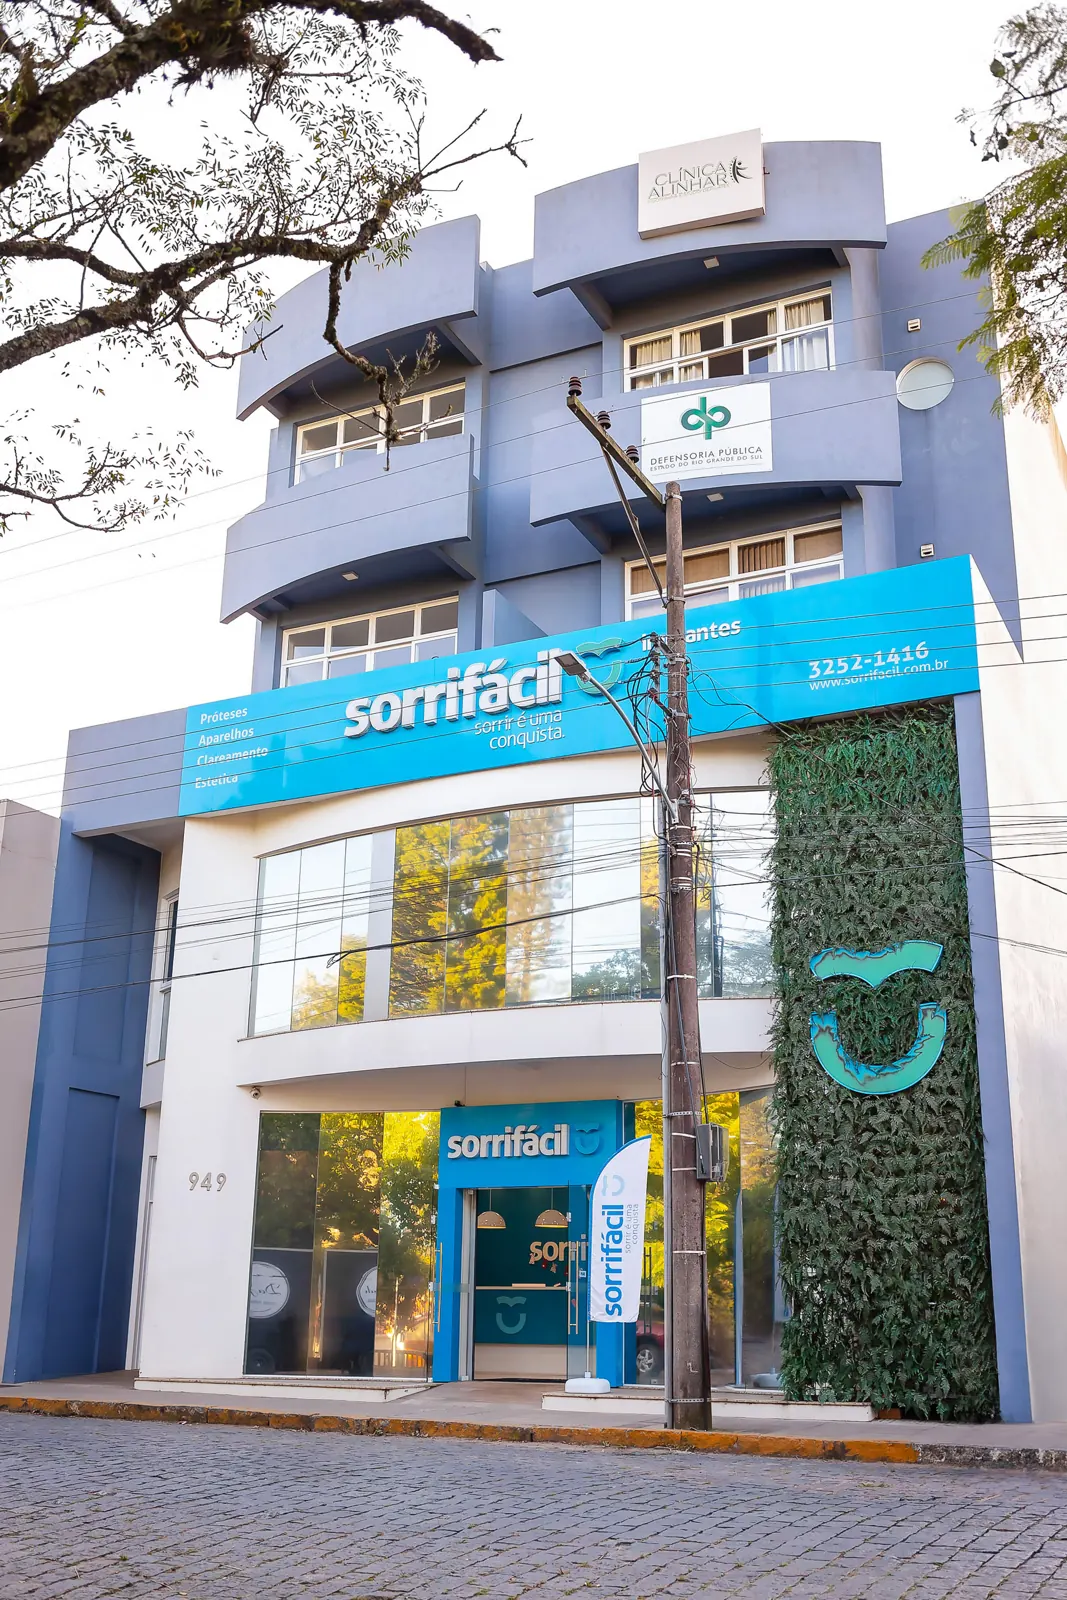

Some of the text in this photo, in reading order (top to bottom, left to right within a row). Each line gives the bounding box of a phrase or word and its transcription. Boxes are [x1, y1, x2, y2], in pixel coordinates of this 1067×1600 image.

[648, 174, 728, 200] ALINHAR
[655, 162, 727, 186] CLÍNICA
[650, 446, 763, 465] DEFENSORIA PÚBLICA
[650, 463, 676, 472] ESTADO
[706, 456, 735, 464] GRANDE
[808, 641, 929, 679] 3252-1416
[809, 659, 949, 691] www.sorrifacil.com.br
[344, 648, 563, 739] sorrifácil
[200, 708, 248, 725] Próteses
[474, 709, 563, 735] sorrir é uma
[198, 727, 254, 748] Aparelhos
[489, 724, 566, 750] conquista.
[197, 746, 268, 766] Clareamento
[447, 1124, 570, 1159] sorrifácil
[188, 1172, 227, 1192] 949
[631, 1203, 640, 1246] conquista
[624, 1230, 632, 1254] sorrir
[601, 1204, 625, 1317] sorrifácil
